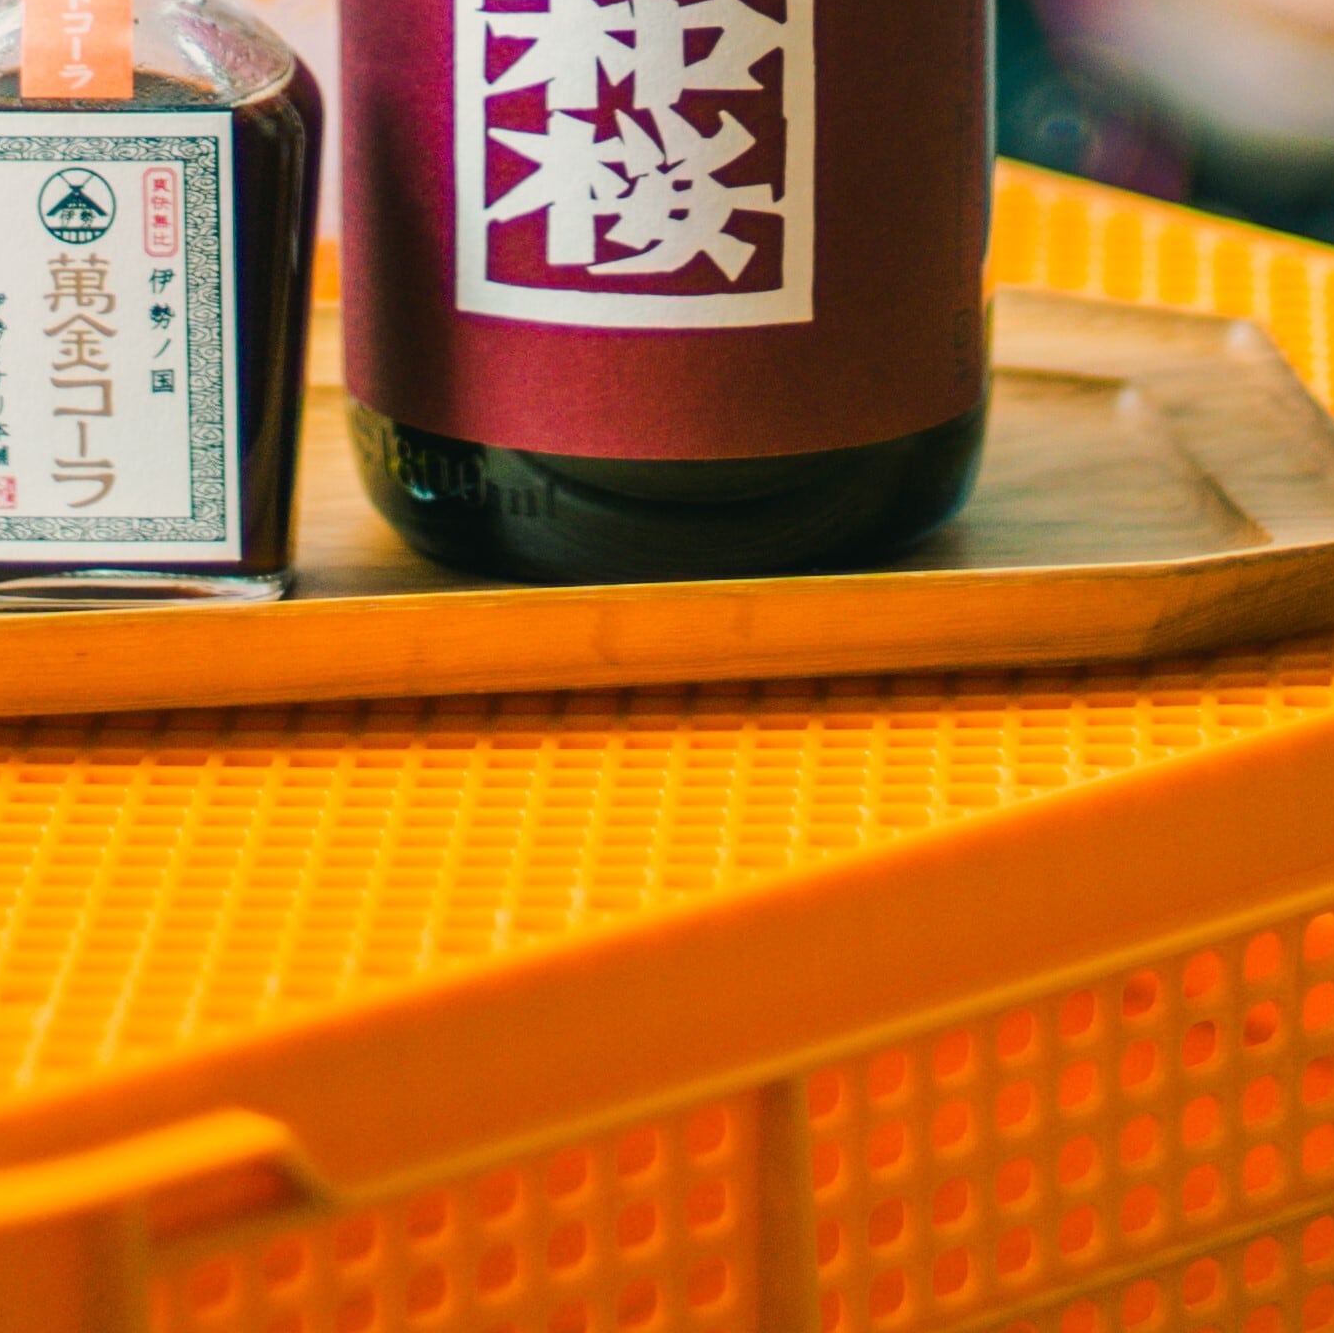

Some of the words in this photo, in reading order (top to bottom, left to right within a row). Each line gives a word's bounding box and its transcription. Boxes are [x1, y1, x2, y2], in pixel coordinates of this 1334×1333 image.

[43, 252, 118, 509] 萬金コーラ
[148, 268, 175, 394] 伊勢ノ国
